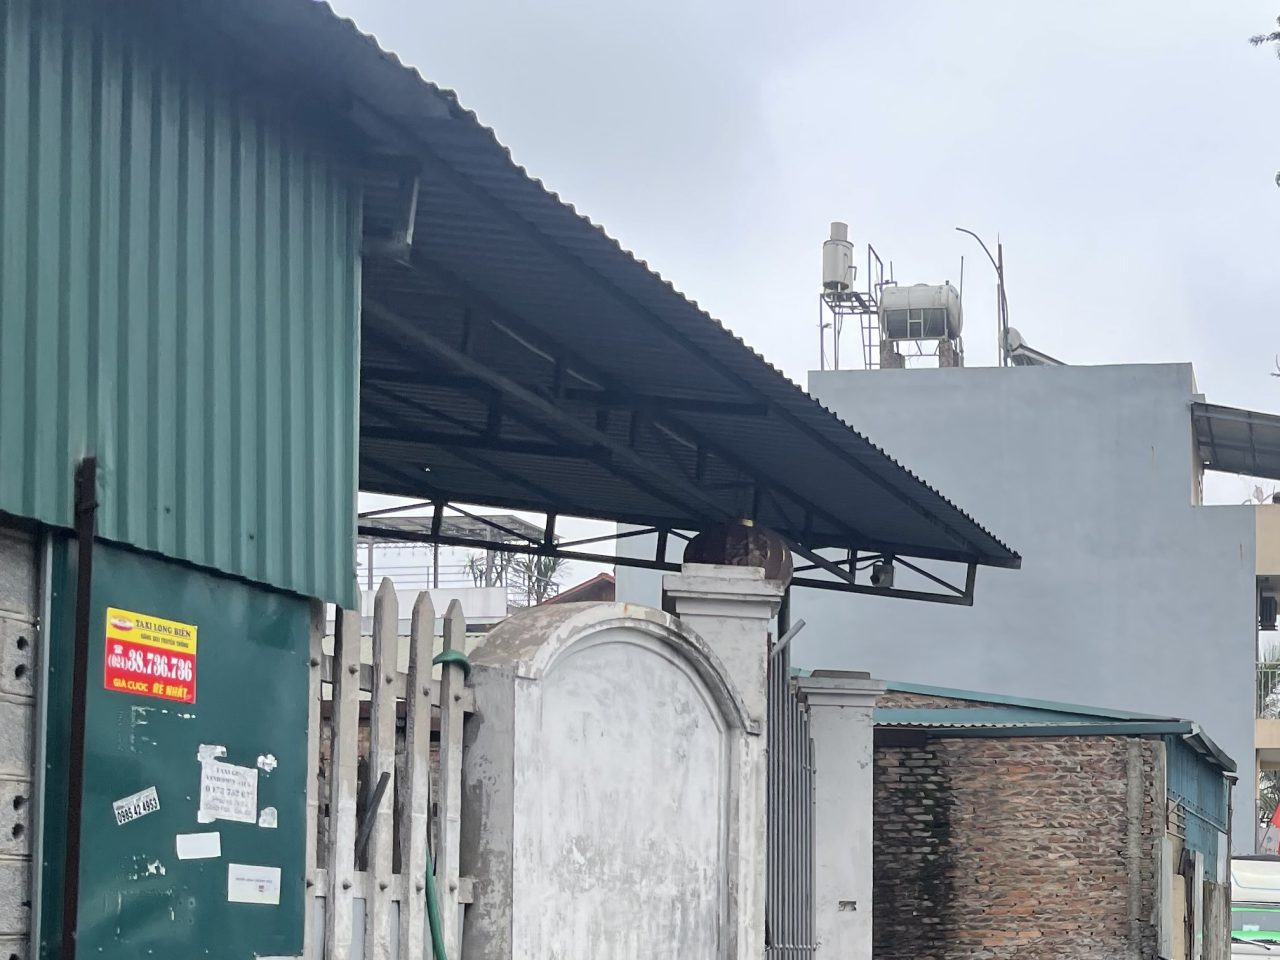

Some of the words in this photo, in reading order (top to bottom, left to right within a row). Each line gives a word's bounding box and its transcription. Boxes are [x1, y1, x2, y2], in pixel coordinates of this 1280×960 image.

[136, 620, 152, 630] TAXI
[153, 624, 173, 634] LONG
[117, 807, 133, 823] 0985
[142, 797, 158, 812] 4953
